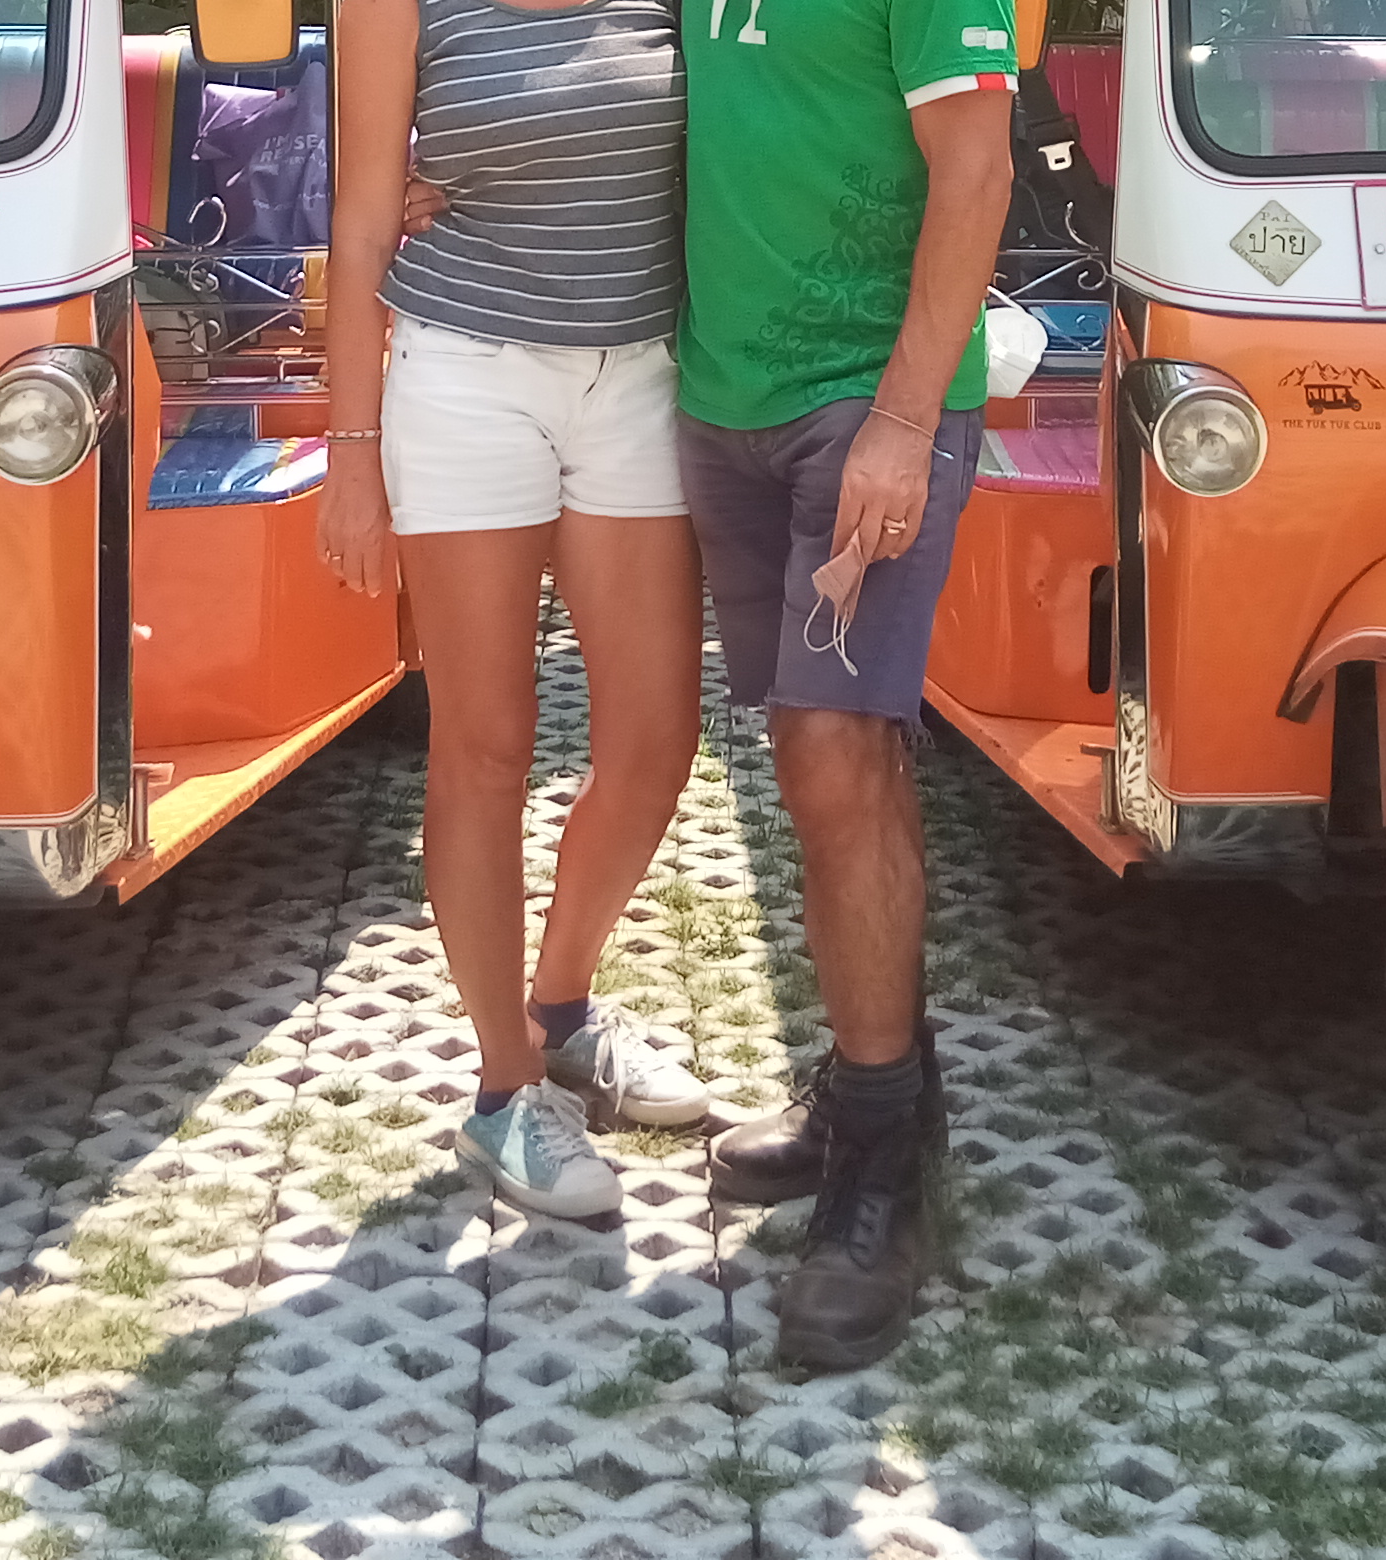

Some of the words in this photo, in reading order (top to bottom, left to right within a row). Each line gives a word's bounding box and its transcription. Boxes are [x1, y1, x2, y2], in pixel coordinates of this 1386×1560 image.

[1249, 226, 1306, 255] ปาย
[1282, 419, 1304, 429] THE
[1353, 421, 1382, 430] CLUB
